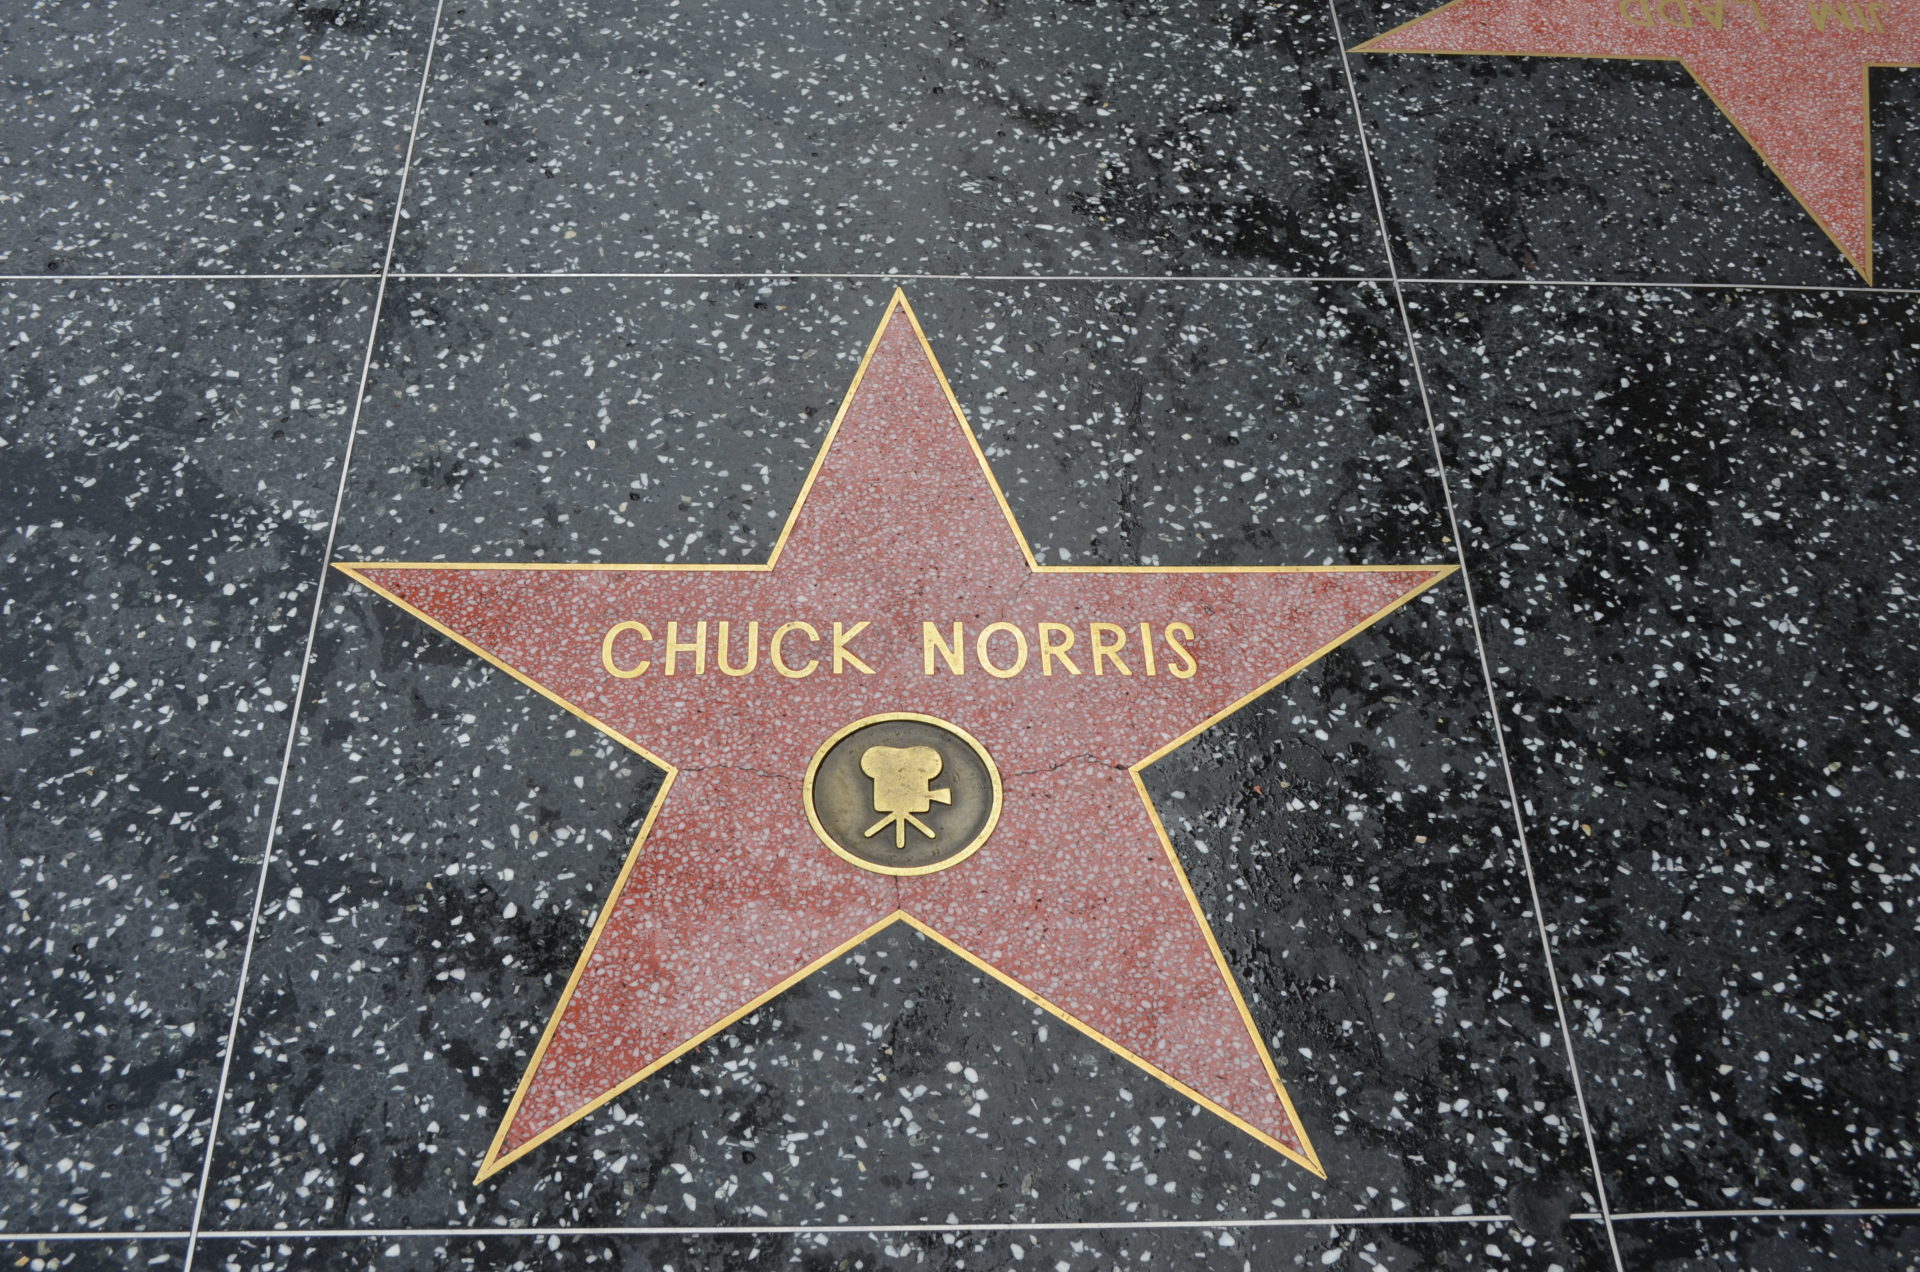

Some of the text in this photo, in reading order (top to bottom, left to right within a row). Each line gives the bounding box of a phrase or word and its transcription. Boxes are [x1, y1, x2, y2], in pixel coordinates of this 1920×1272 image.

[1619, 0, 1890, 33] JIM LADD
[600, 619, 1198, 680] CHUCK NORRIS
